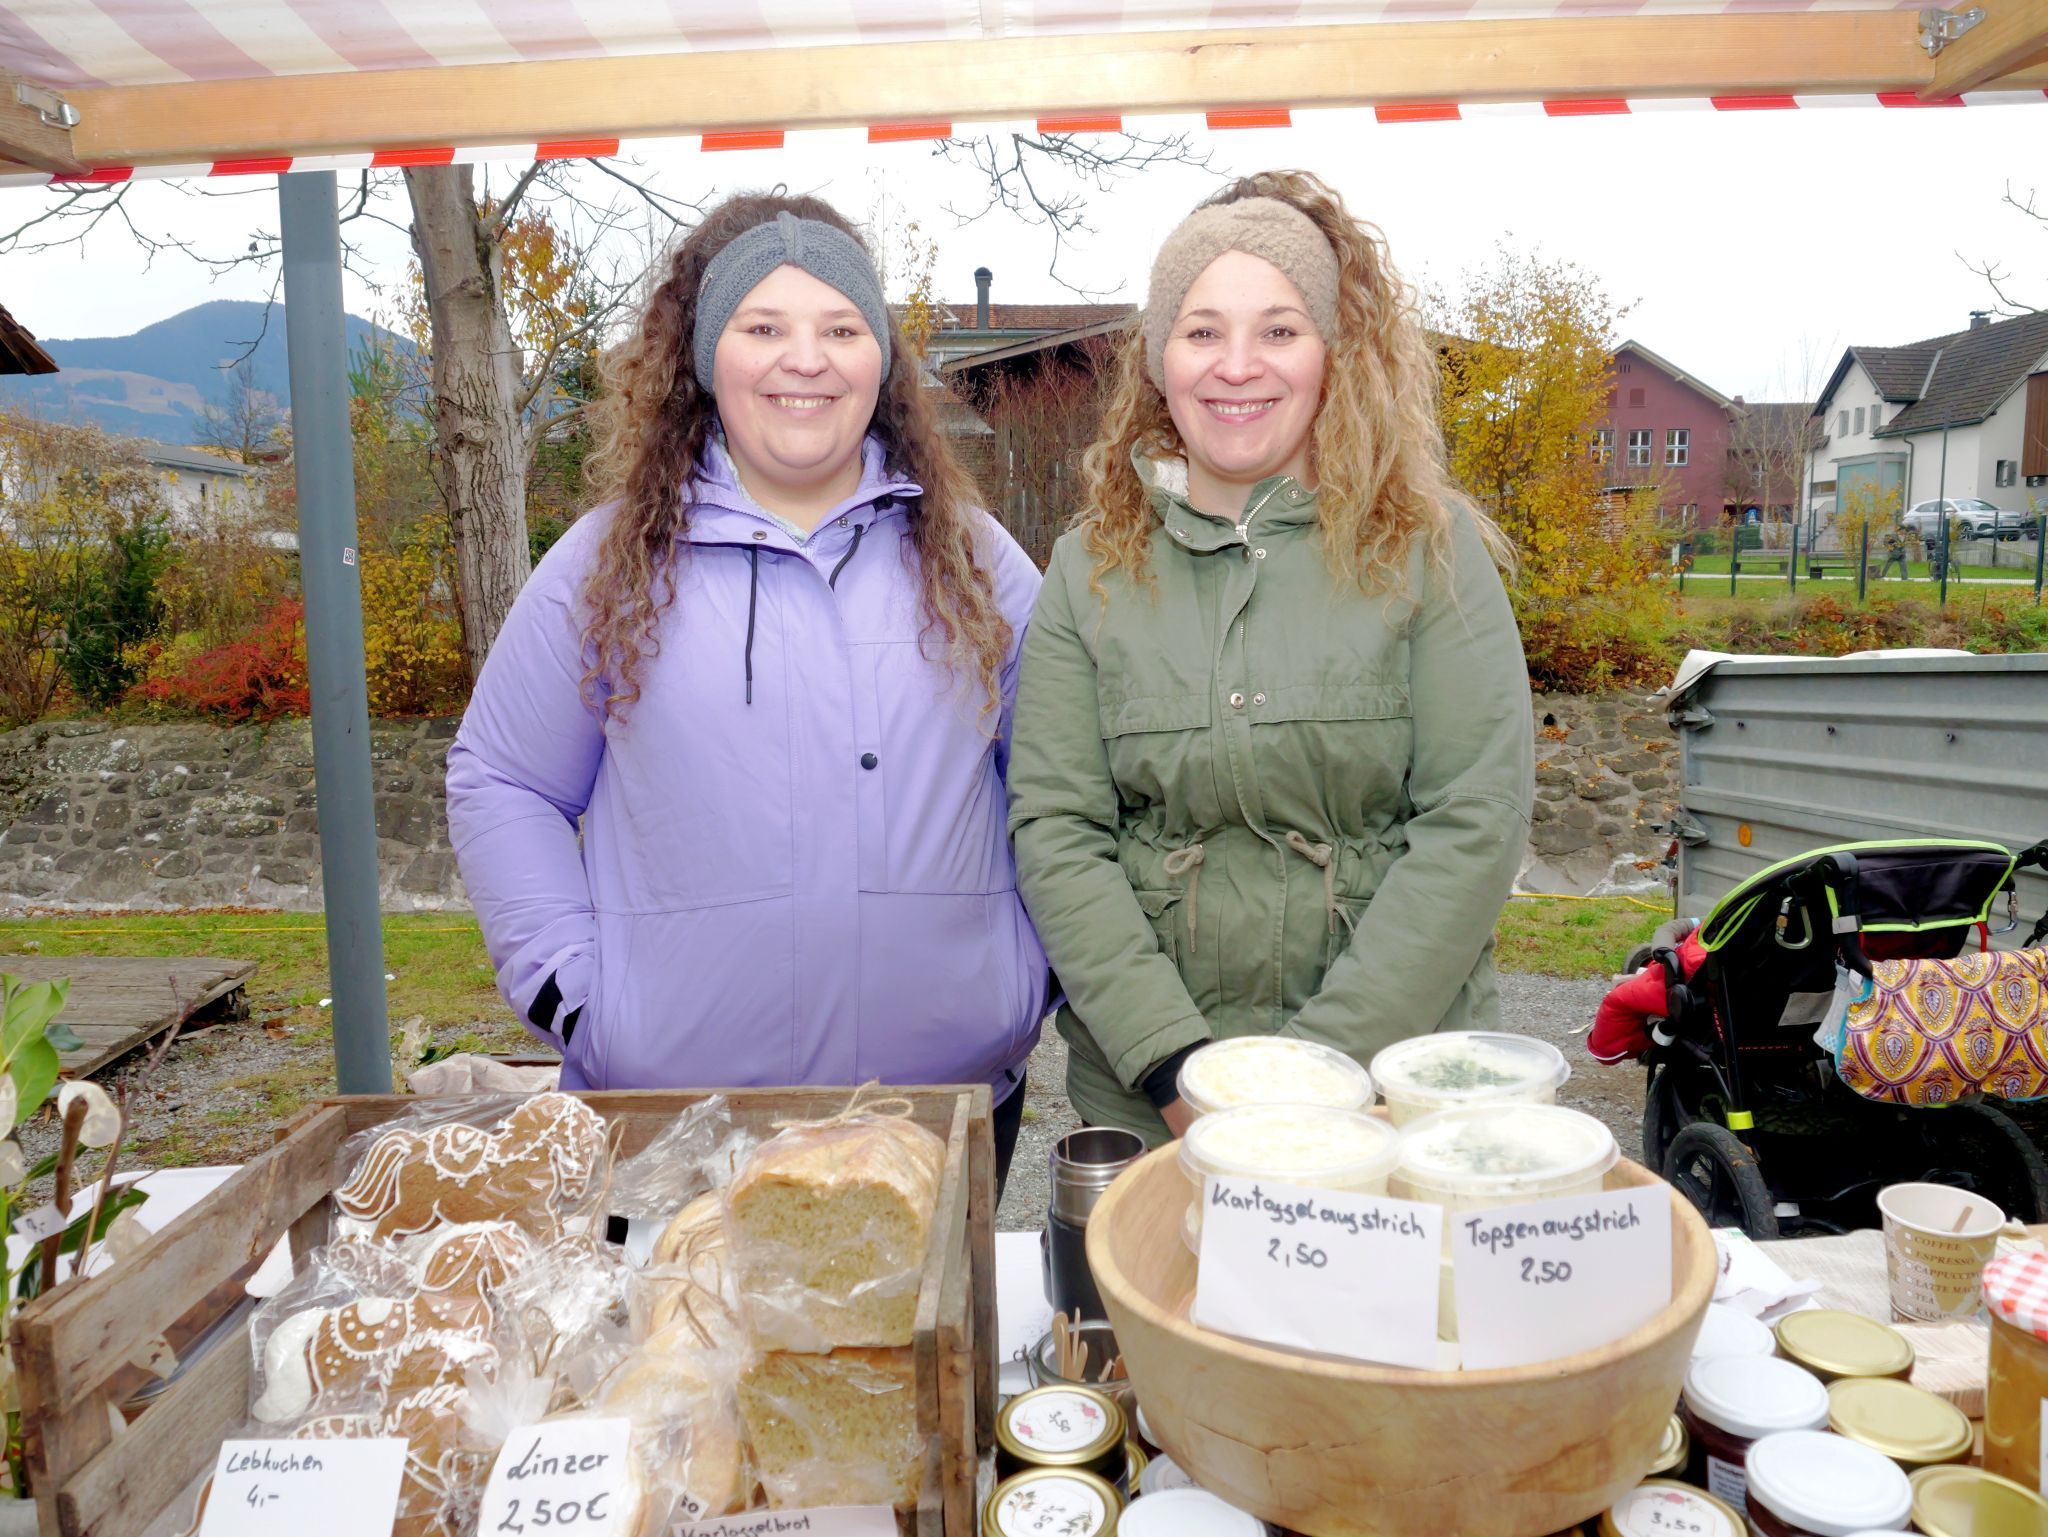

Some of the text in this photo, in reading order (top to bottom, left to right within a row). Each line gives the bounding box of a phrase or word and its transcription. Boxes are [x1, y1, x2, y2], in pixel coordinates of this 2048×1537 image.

[1211, 1183, 1425, 1239] Kartoffelaufstrich
[1465, 1203, 1641, 1255] Topfenaufstrich
[1267, 1238, 1328, 1269] 2,50
[1914, 1236, 1960, 1251] COFFEE
[1915, 1250, 1975, 1265] ESPRESSO
[1520, 1257, 1573, 1284] 2,50
[1916, 1290, 1934, 1305] TEA
[226, 1448, 323, 1473] Lebkuchen
[506, 1437, 609, 1480] Linzer
[247, 1484, 280, 1509] 4,-
[1651, 1511, 1702, 1533] 3,50
